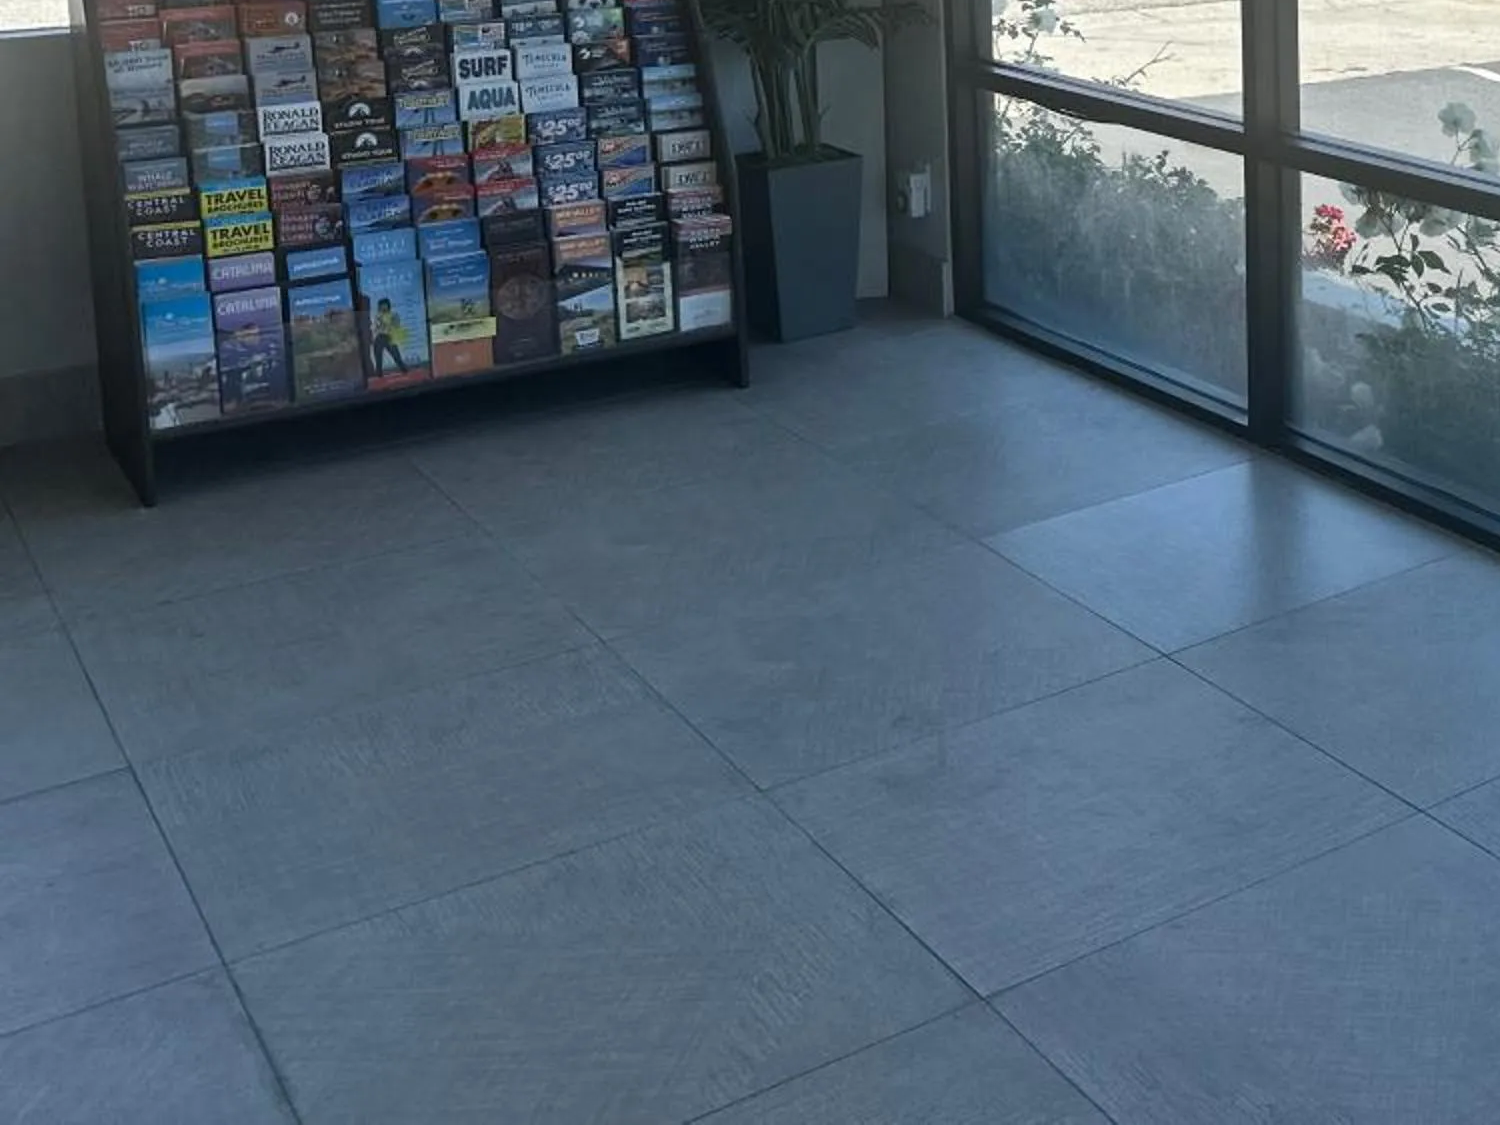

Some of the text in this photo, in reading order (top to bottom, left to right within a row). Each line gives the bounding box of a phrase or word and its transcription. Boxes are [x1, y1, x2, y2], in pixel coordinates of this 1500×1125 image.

[458, 55, 509, 80] SURF
[467, 86, 517, 111] AQUA
[263, 106, 319, 121] RONALD
[270, 141, 326, 155] RONALD
[127, 196, 185, 209] CENTRAL
[206, 189, 265, 206] TRAVEL
[135, 204, 178, 216] COAST
[138, 228, 196, 241] CENTRAL
[210, 222, 271, 241] TRAVEL
[146, 237, 189, 248] COAST
